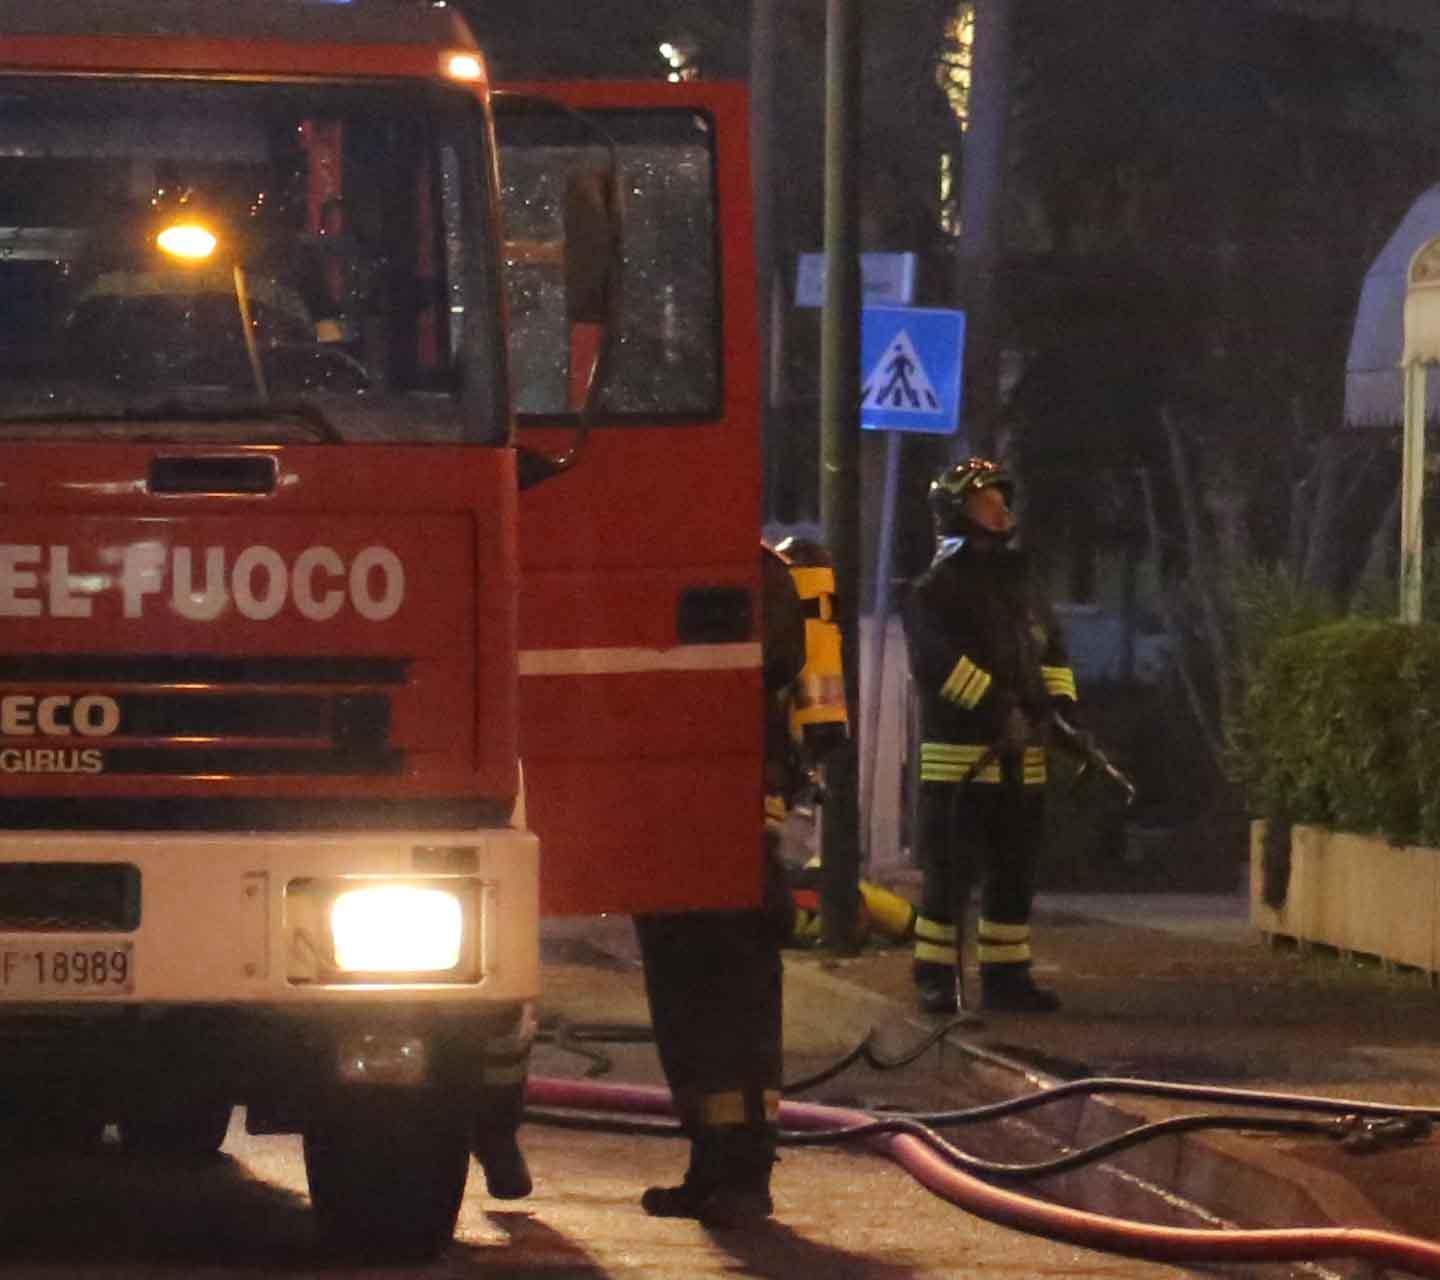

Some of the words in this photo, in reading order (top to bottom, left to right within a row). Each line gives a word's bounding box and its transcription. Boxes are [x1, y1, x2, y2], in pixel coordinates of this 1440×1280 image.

[122, 542, 405, 621] FUOCO
[1, 695, 121, 736] ECO
[34, 951, 128, 985] 18989
